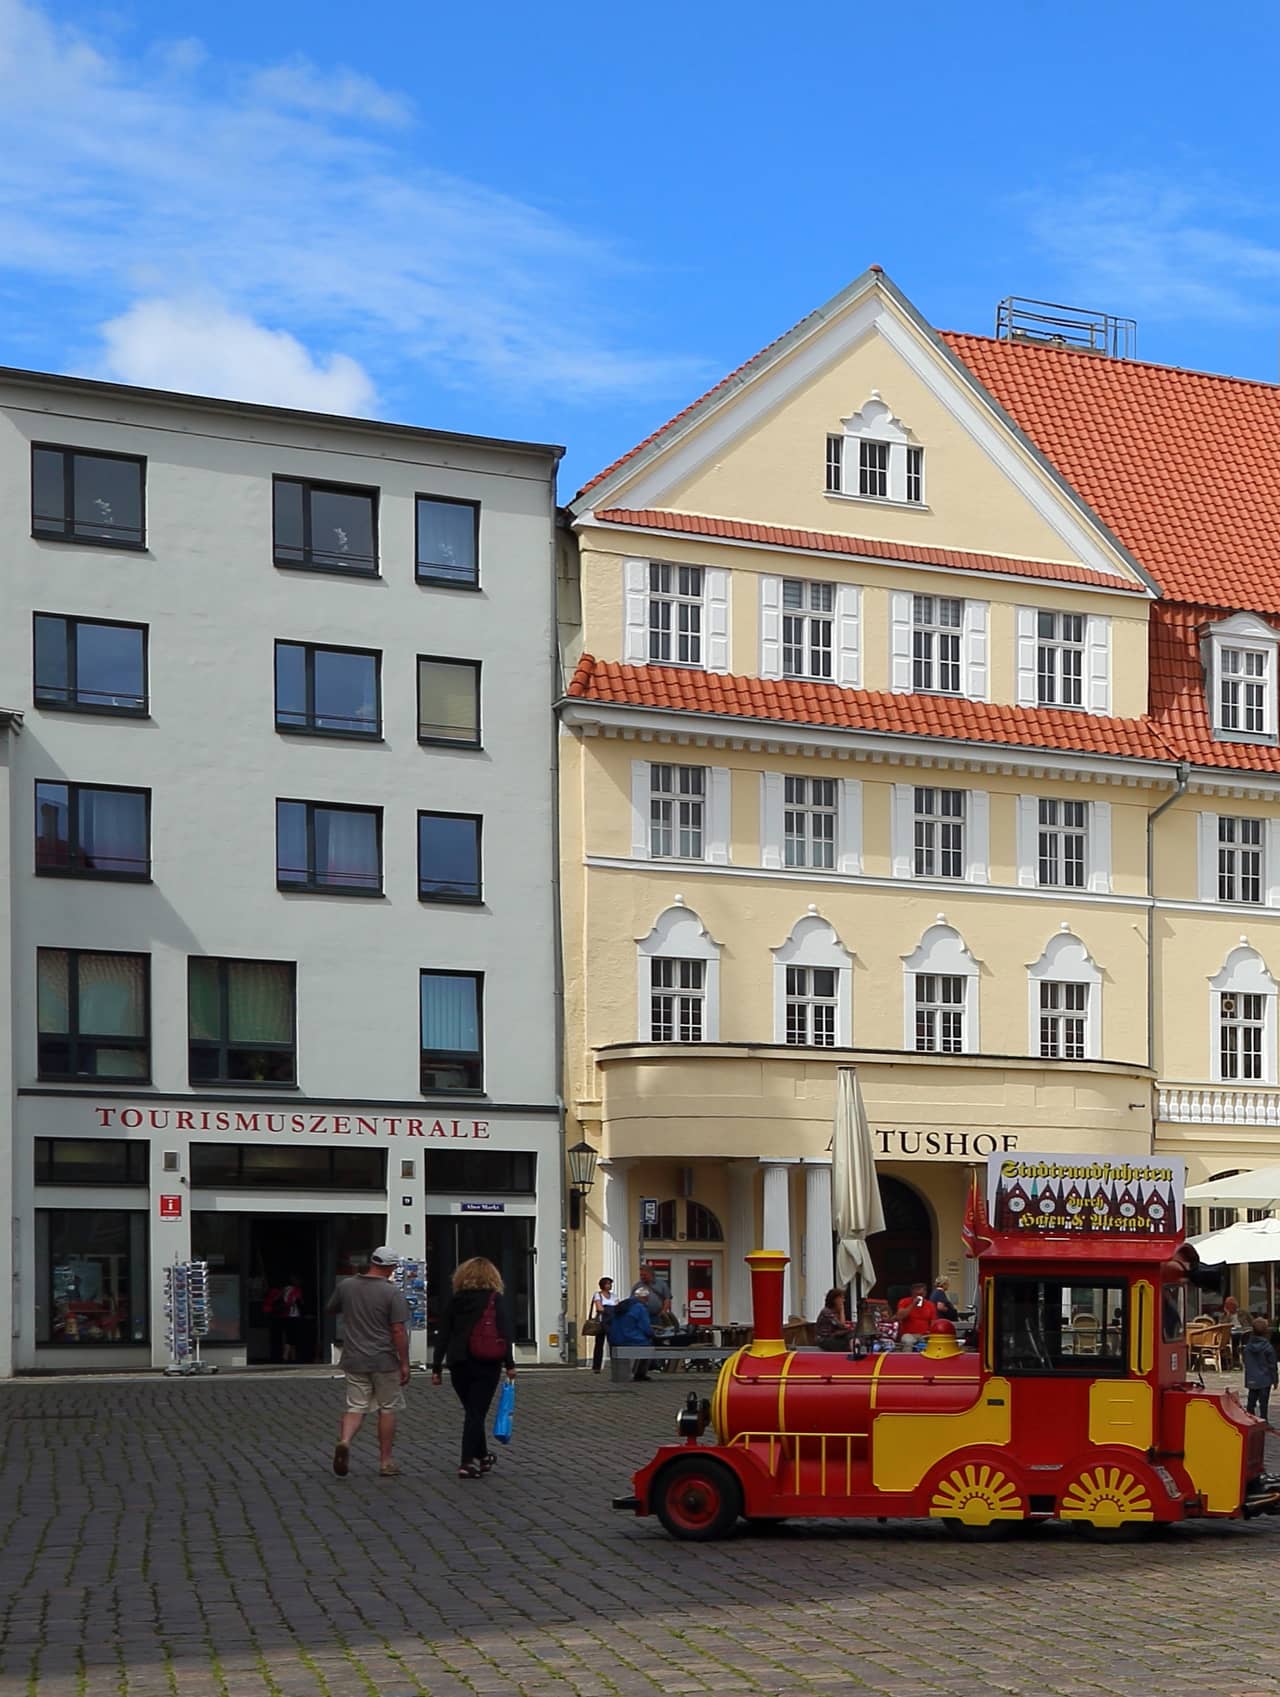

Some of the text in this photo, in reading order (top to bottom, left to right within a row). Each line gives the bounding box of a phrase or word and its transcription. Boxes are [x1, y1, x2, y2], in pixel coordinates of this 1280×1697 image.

[95, 1107, 490, 1139] TOURISMUSZENTRALE
[824, 1129, 1018, 1157] TUSHOF
[1001, 1159, 1173, 1185] Stadtrundfahrten
[1067, 1195, 1105, 1209] durch
[1020, 1212, 1067, 1227] Hafen
[1090, 1213, 1152, 1228] Altstadt
